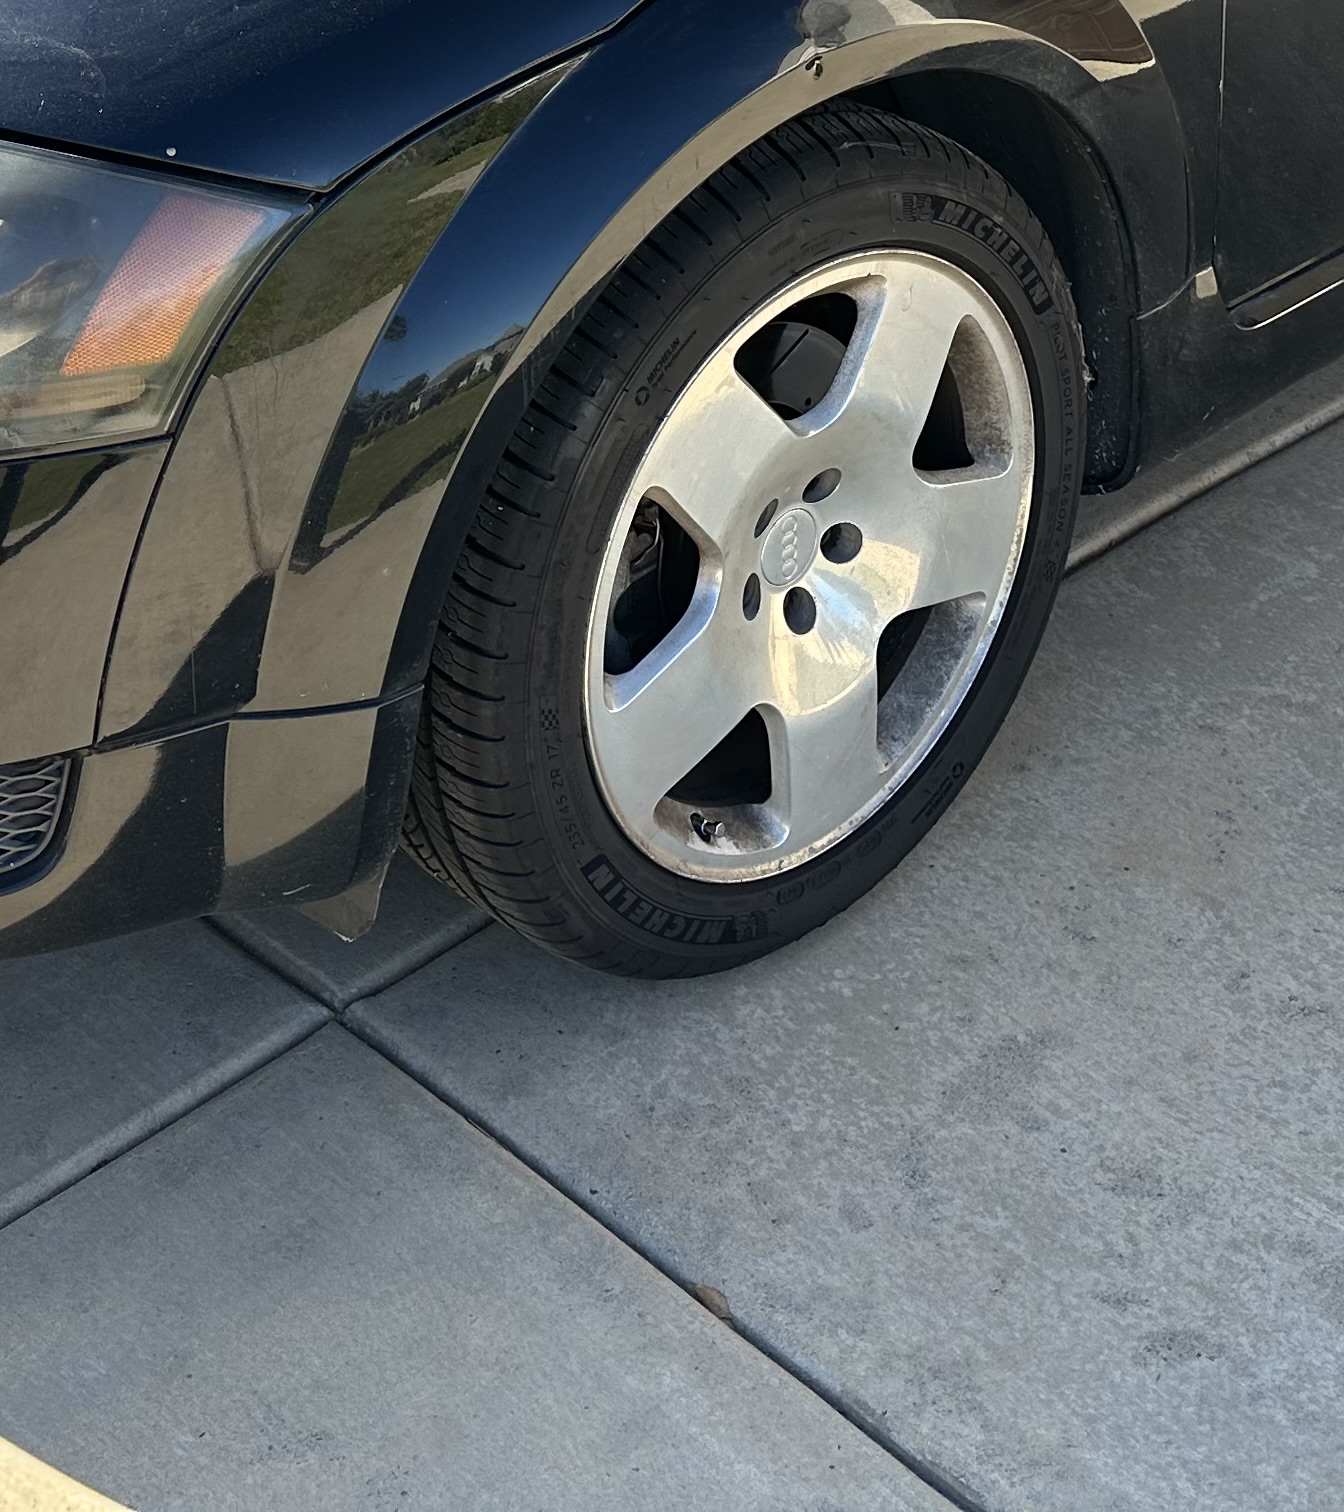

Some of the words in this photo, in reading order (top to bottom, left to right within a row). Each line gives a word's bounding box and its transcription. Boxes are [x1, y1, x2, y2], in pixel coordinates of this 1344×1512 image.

[939, 200, 1049, 307] MICHELIN
[646, 337, 681, 385] MICHELIN
[1060, 367, 1074, 417] SPORT
[1064, 426, 1074, 457] ALL
[1056, 462, 1072, 534] SEASON
[555, 794, 586, 850] 235/45
[588, 863, 727, 943] MICHELIN
